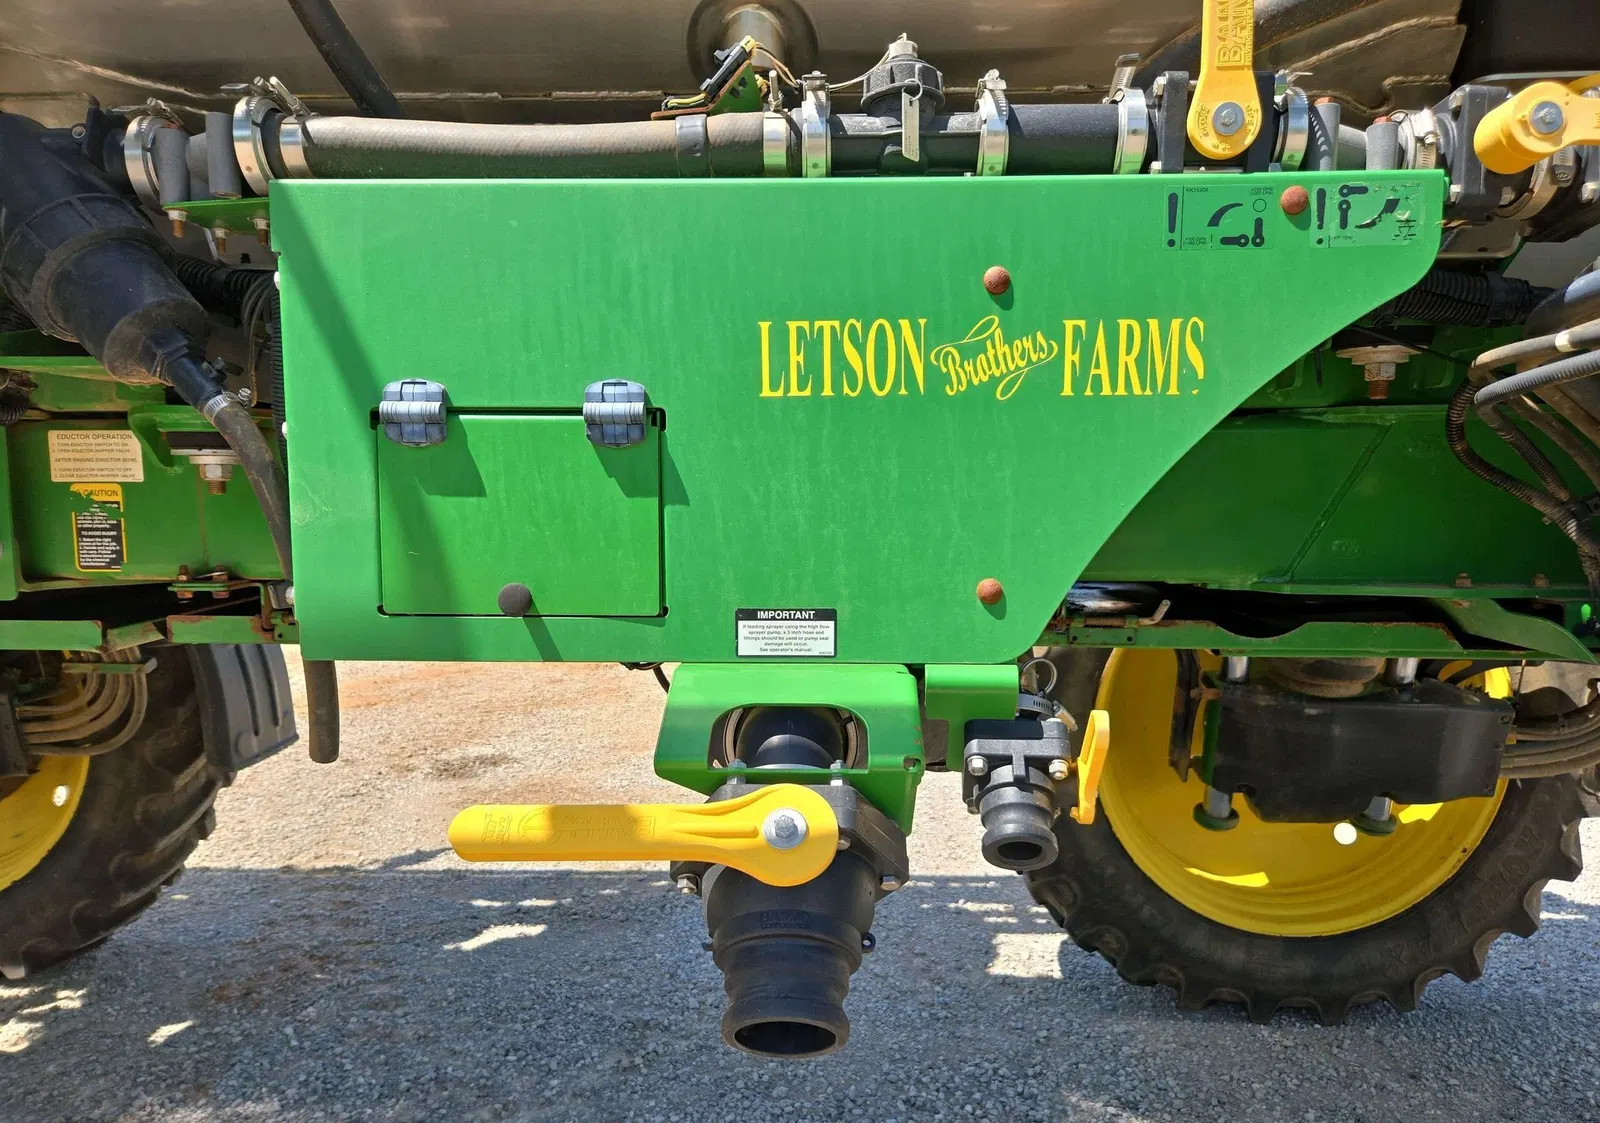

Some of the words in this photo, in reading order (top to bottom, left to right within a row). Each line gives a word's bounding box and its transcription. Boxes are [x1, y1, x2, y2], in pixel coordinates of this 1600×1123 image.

[757, 318, 928, 397] LETSON
[930, 314, 1059, 401] Brothers
[1060, 316, 1205, 397] FARMS
[757, 610, 816, 619] IMPORTANT
